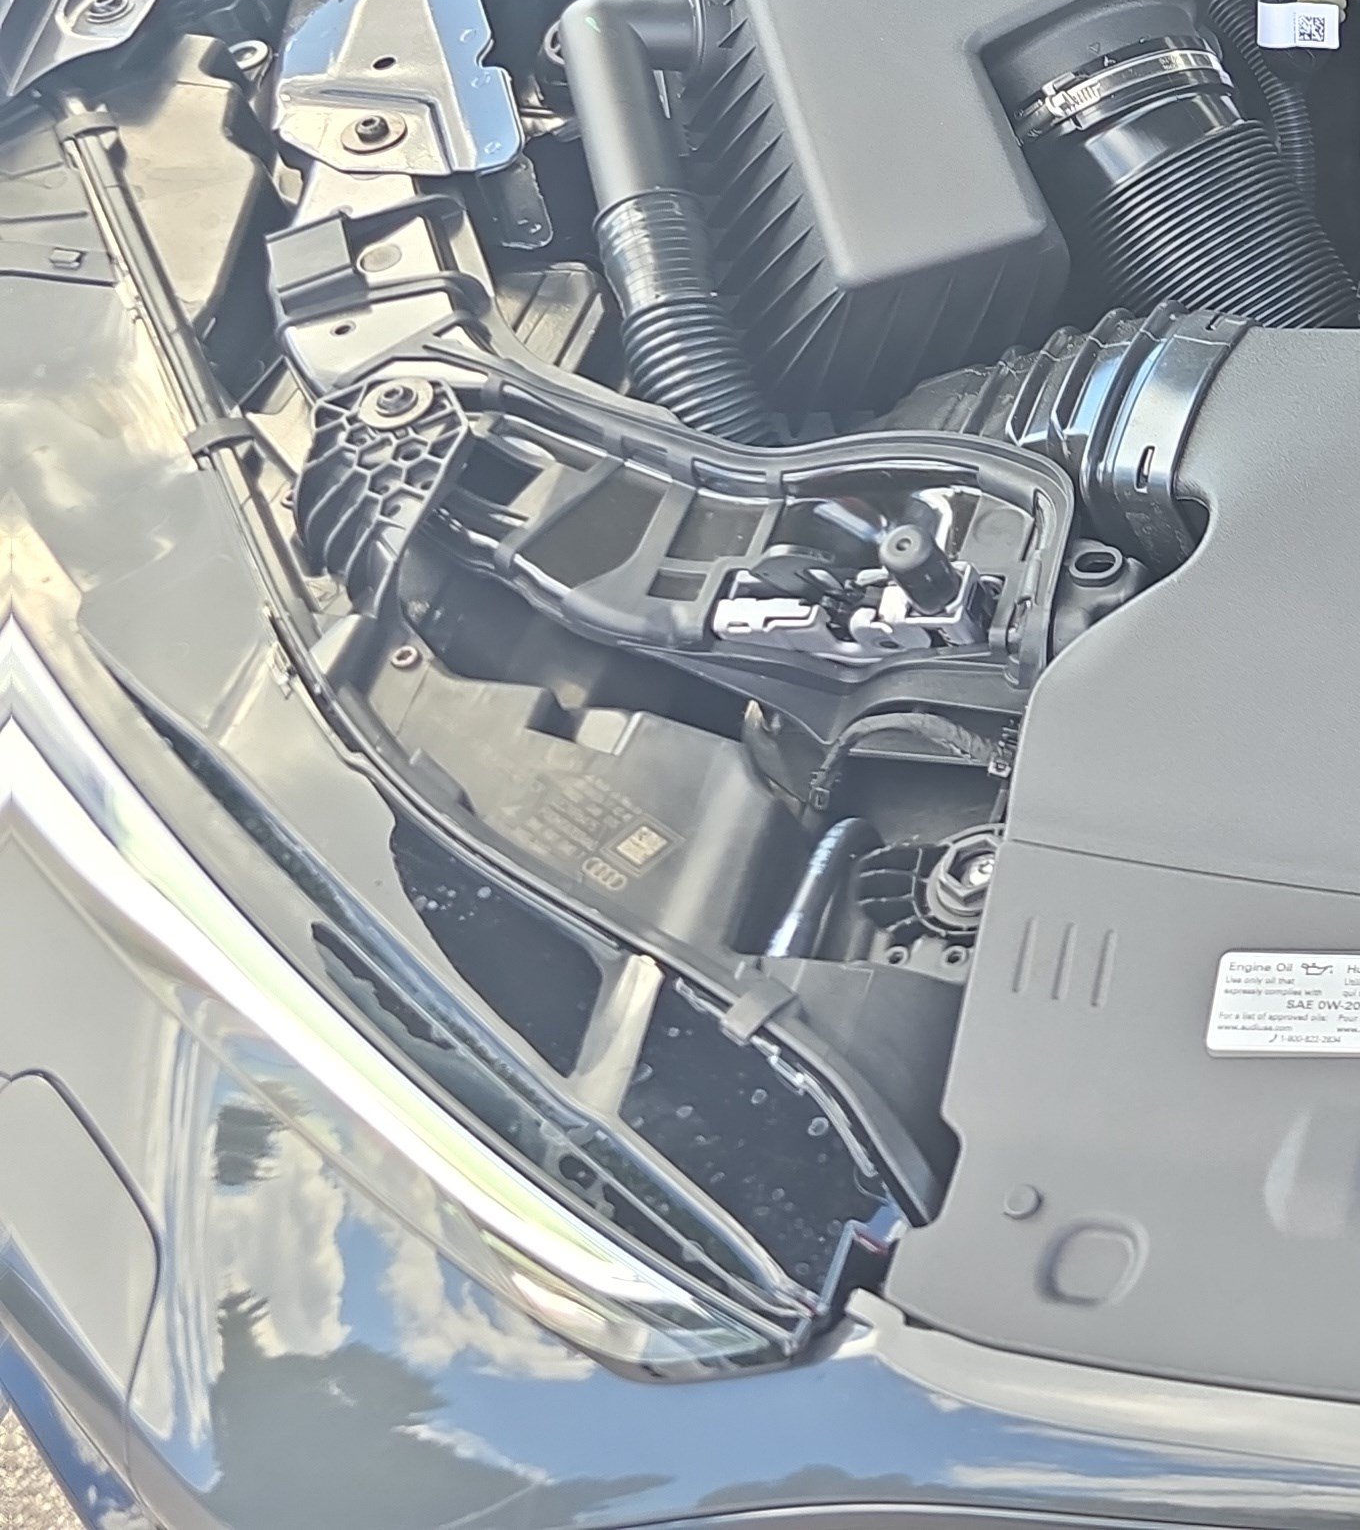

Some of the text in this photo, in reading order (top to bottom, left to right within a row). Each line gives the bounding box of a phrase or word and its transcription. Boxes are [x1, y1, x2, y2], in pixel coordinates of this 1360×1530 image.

[1229, 962, 1293, 973] Engine Oil
[1244, 977, 1263, 985] only
[1343, 990, 1356, 998] qui
[1286, 1000, 1313, 1009] SAE
[1318, 1001, 1360, 1010] 0W-20
